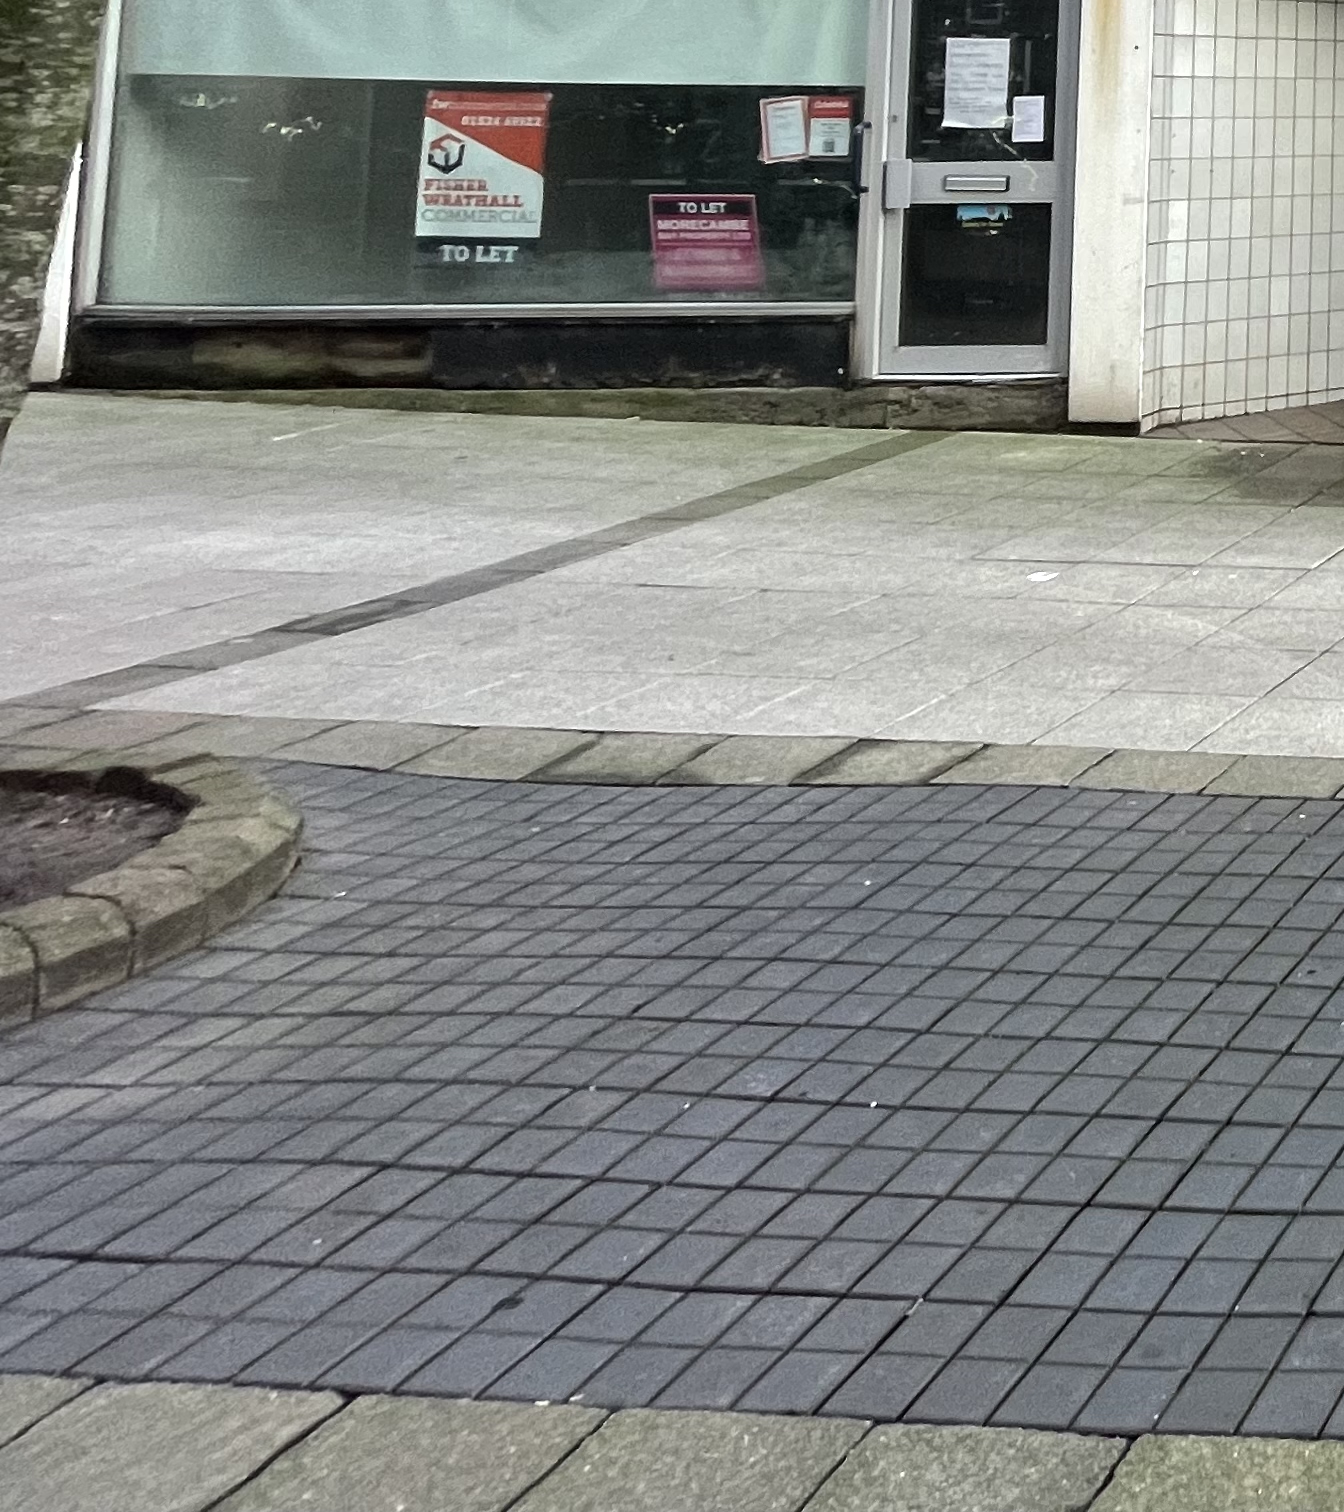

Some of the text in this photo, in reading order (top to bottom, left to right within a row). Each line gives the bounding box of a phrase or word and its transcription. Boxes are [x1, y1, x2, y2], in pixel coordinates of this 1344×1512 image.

[424, 178, 489, 191] FISHER
[679, 202, 727, 213] TO LET
[421, 209, 538, 223] COMMERCIAL
[439, 244, 519, 263] TO LET
